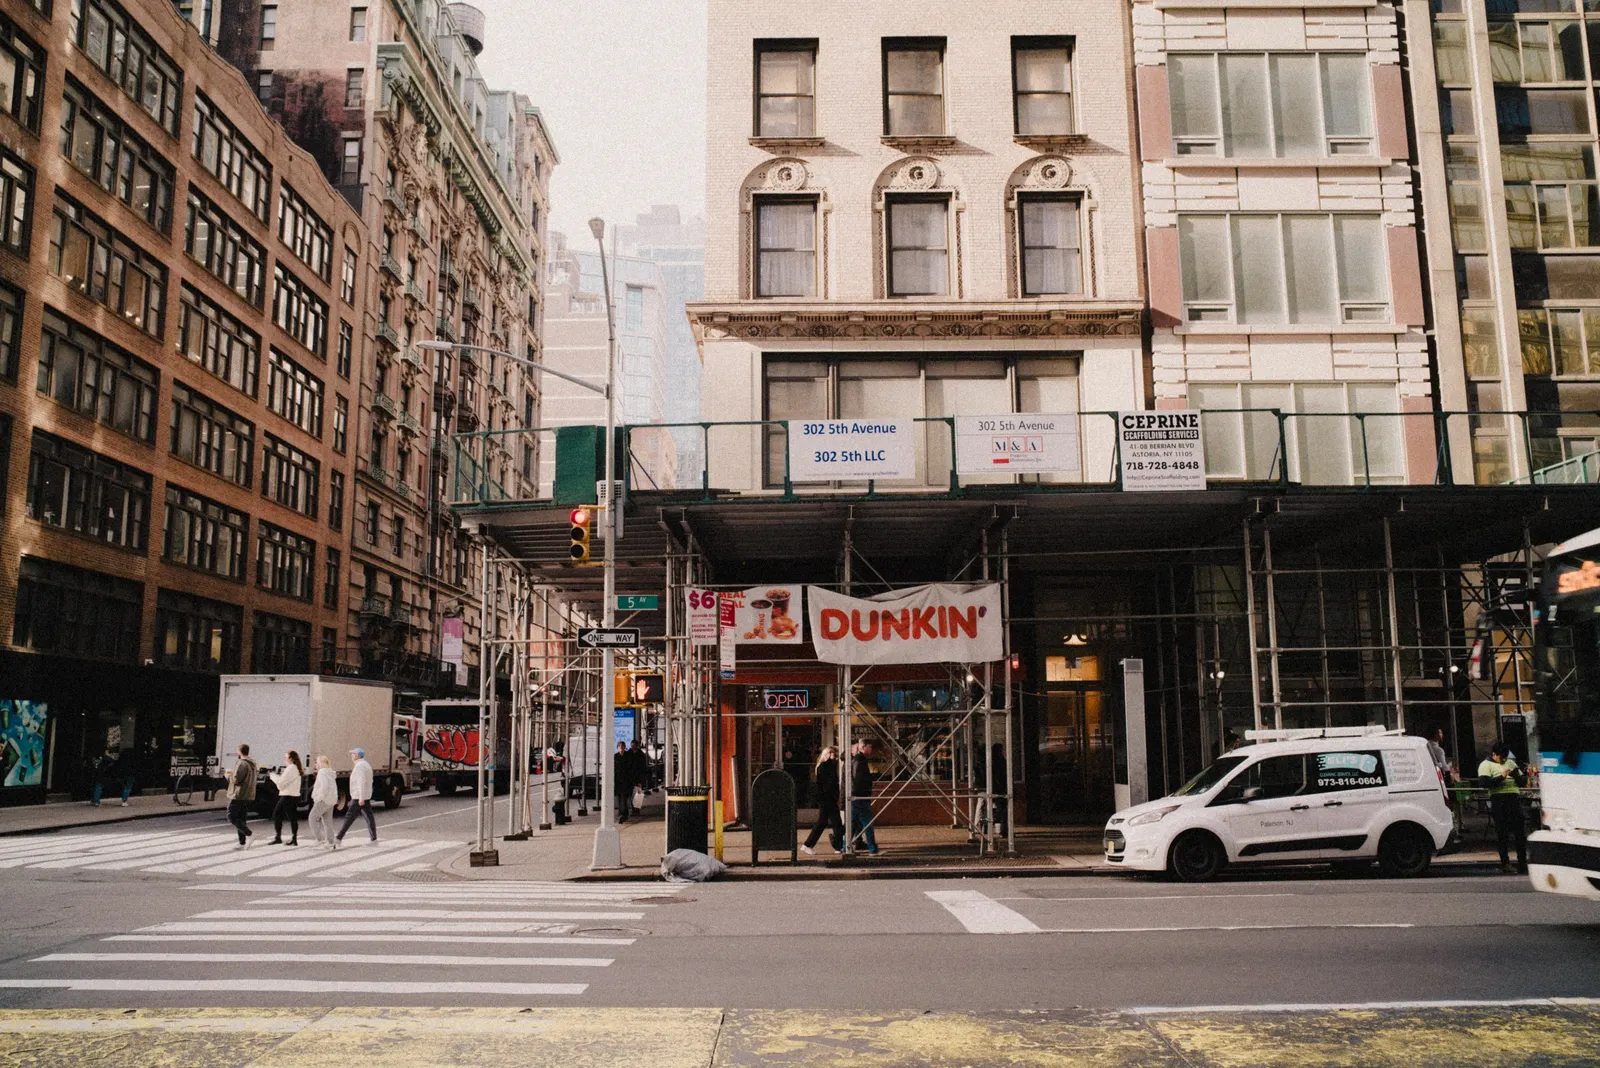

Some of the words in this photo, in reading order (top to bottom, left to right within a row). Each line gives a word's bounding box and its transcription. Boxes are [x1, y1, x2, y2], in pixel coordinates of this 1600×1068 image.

[978, 421, 996, 431] 302
[1000, 420, 1015, 431] 5th
[1018, 420, 1055, 430] Avenue
[1122, 413, 1199, 429] CEPRINE
[803, 423, 825, 435] 302
[828, 422, 848, 434] 5th
[851, 422, 897, 434] Avenue
[1124, 431, 1167, 440] SCAFFOLDING
[1168, 430, 1198, 439] SERVICES
[814, 451, 837, 462] 302
[841, 450, 862, 462] 5th
[864, 449, 886, 461] LLC
[1126, 461, 1199, 470] 718-728-4848
[627, 596, 635, 608] 5
[689, 590, 715, 610] $6
[820, 604, 987, 641] DUNKIN'
[587, 634, 605, 642] ONE
[615, 634, 633, 642] WAY
[768, 694, 806, 708] OPEN
[170, 766, 190, 777] EVERY
[190, 766, 203, 776] BITE
[1317, 776, 1382, 786] 973-816-0604
